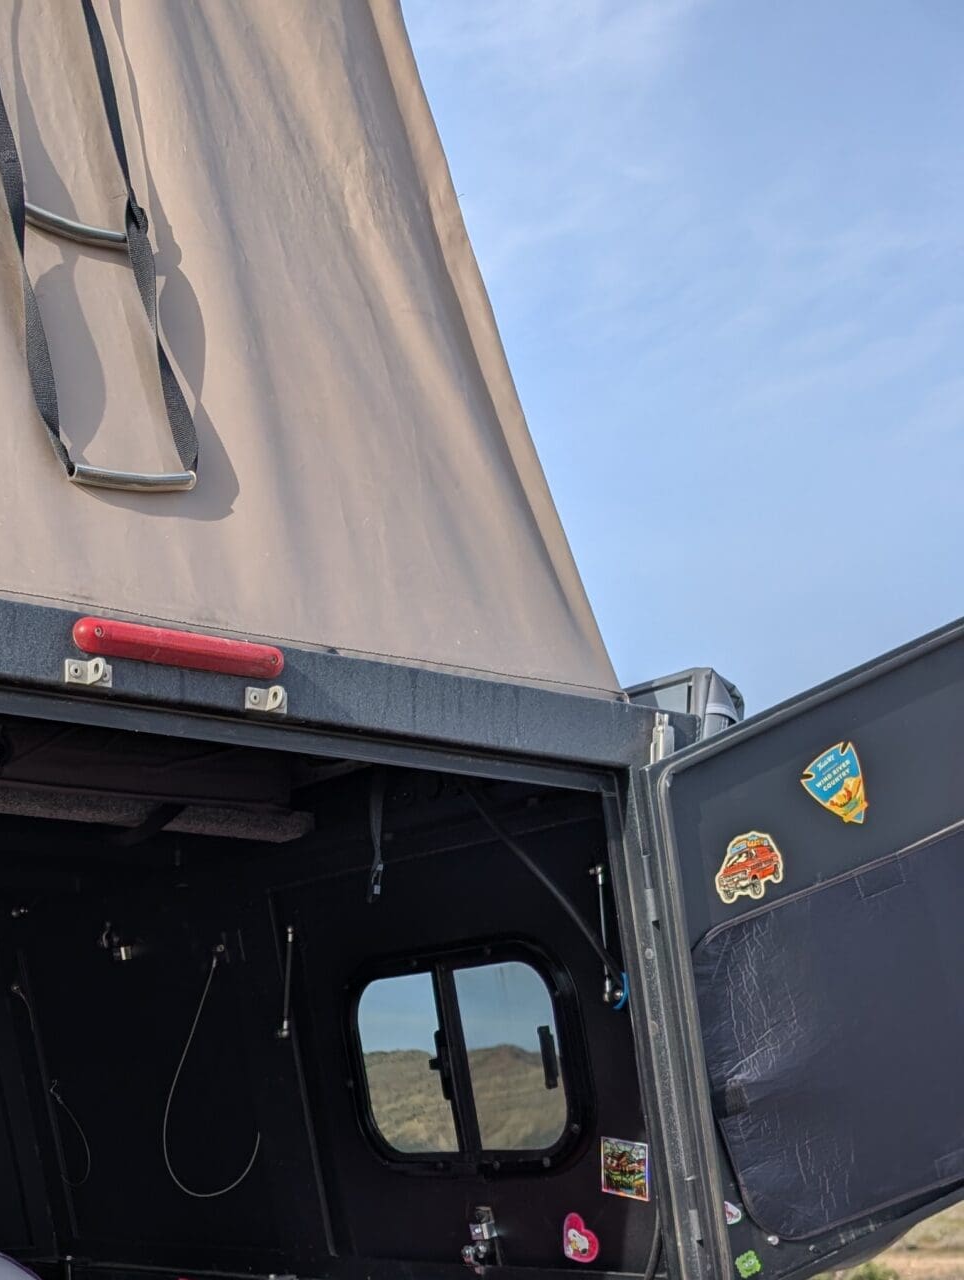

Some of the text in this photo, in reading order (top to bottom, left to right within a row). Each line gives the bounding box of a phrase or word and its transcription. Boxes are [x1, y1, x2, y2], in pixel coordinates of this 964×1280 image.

[815, 773, 833, 788] WIND
[832, 759, 851, 776] RIVER
[822, 768, 850, 792] COUNTRY
